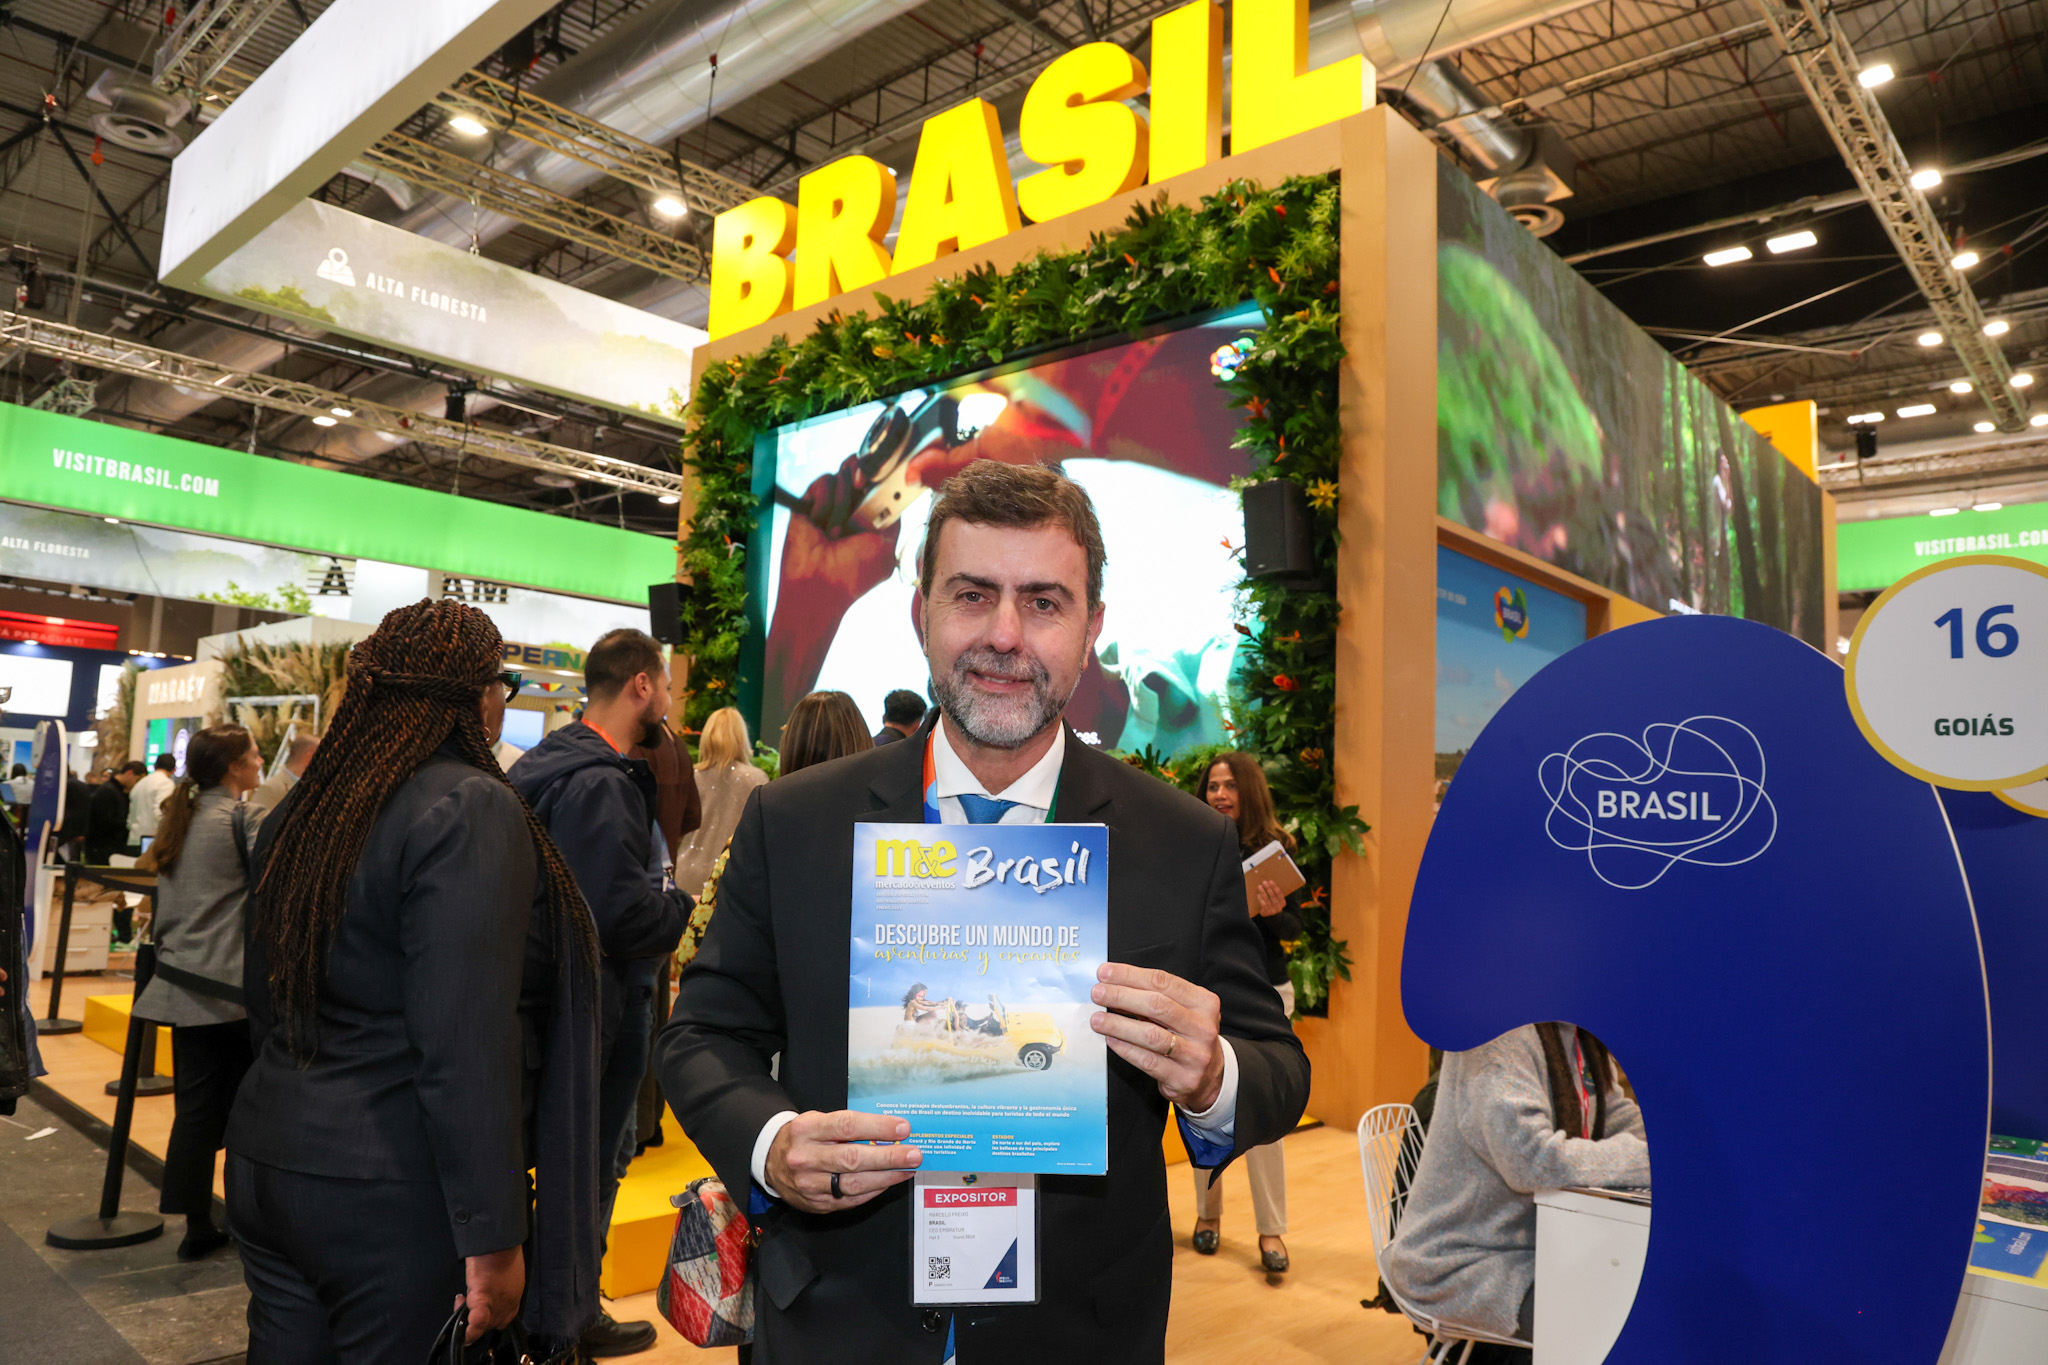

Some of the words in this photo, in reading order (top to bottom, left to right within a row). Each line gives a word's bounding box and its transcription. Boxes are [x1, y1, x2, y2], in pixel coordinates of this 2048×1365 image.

[708, 0, 1376, 342] BRASIL
[365, 272, 404, 298] ALTA
[411, 286, 488, 323] FLORESTA
[52, 448, 220, 497] VISITBRASIL.COM
[1, 536, 29, 551] ALTA
[34, 541, 90, 559] FLORESTA
[1934, 604, 2019, 659] 16
[1934, 713, 2015, 736] GOIÁS
[1598, 790, 1722, 821] BRASIL
[875, 839, 958, 879] m&e
[961, 841, 1090, 894] Brasil
[875, 880, 956, 889] mercado&eventos
[875, 923, 961, 945] DESCUBRE
[965, 925, 988, 946] UN
[993, 925, 1053, 947] MUNDO
[1058, 926, 1080, 947] DE
[874, 943, 969, 965] aventuras
[976, 951, 990, 976] y
[999, 945, 1080, 966] encantos
[935, 1192, 1007, 1203] EXPOSITOR
